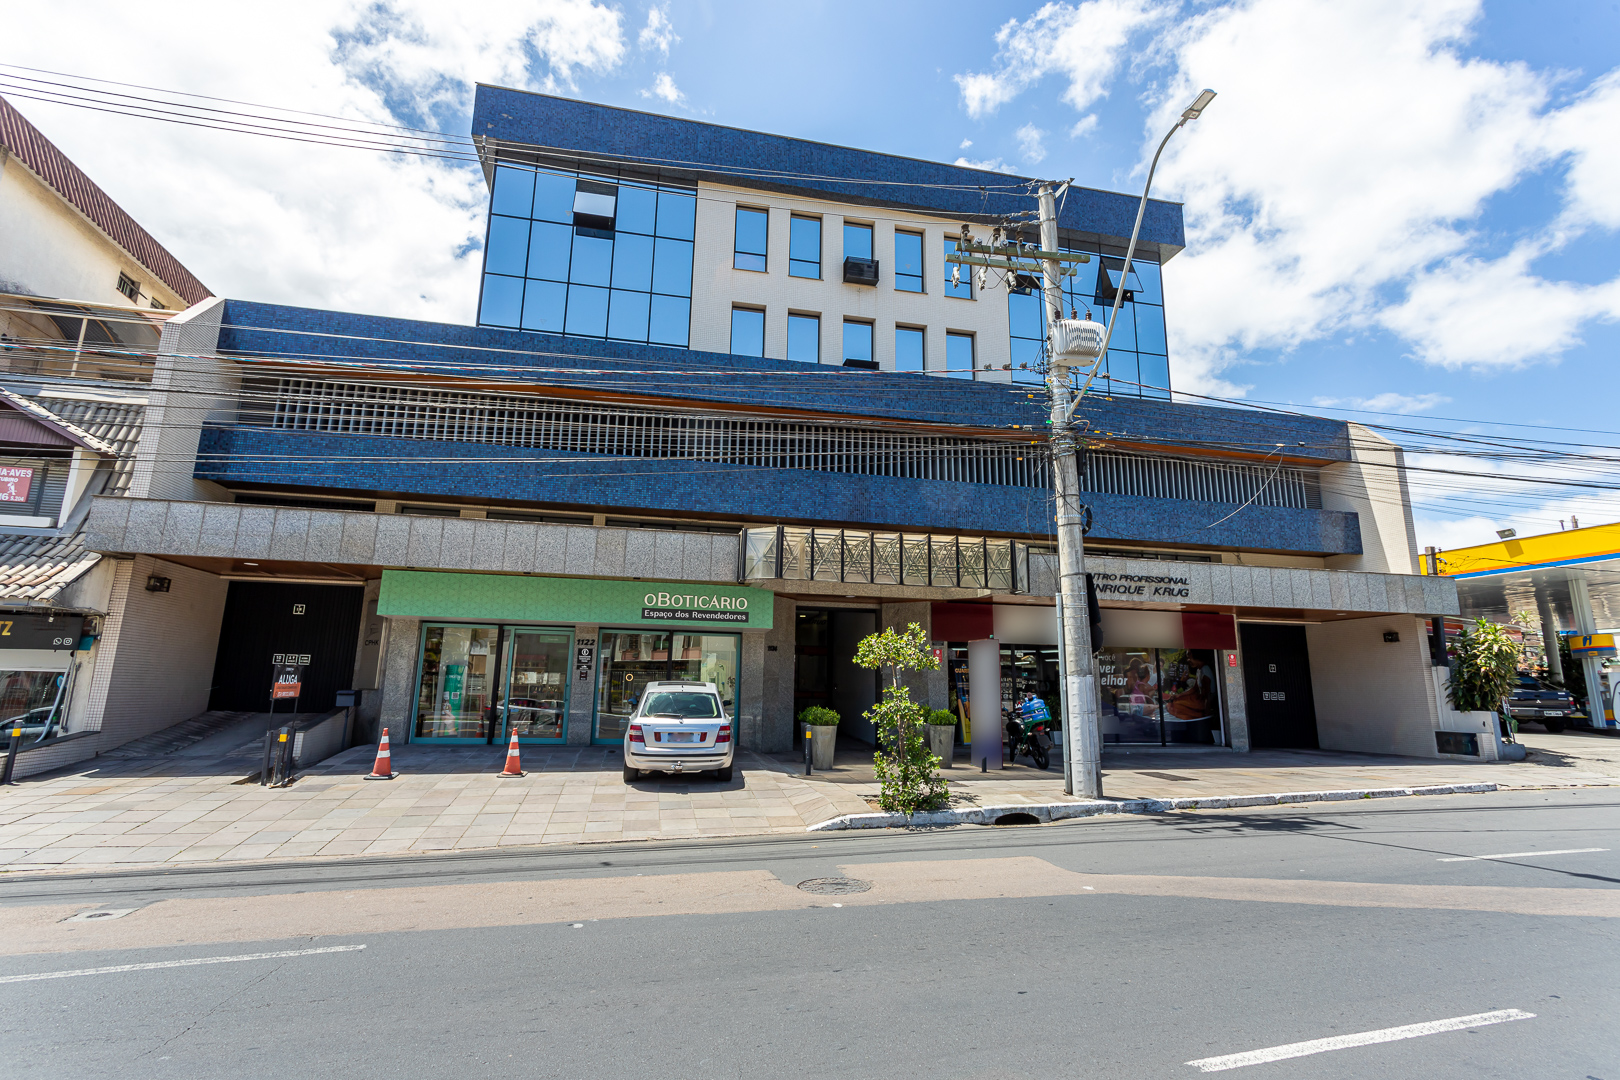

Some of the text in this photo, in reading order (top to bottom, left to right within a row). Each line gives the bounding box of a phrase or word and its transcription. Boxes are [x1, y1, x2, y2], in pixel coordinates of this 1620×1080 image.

[1119, 574, 1190, 586] PROFISSIONAL
[1094, 583, 1190, 598] NRIQUE KRUG
[644, 609, 747, 621] Espaço dos Revendedores
[577, 638, 596, 646] 1122
[1100, 665, 1116, 674] ver
[278, 674, 298, 685] ALUGA
[1101, 674, 1129, 686] elhor
